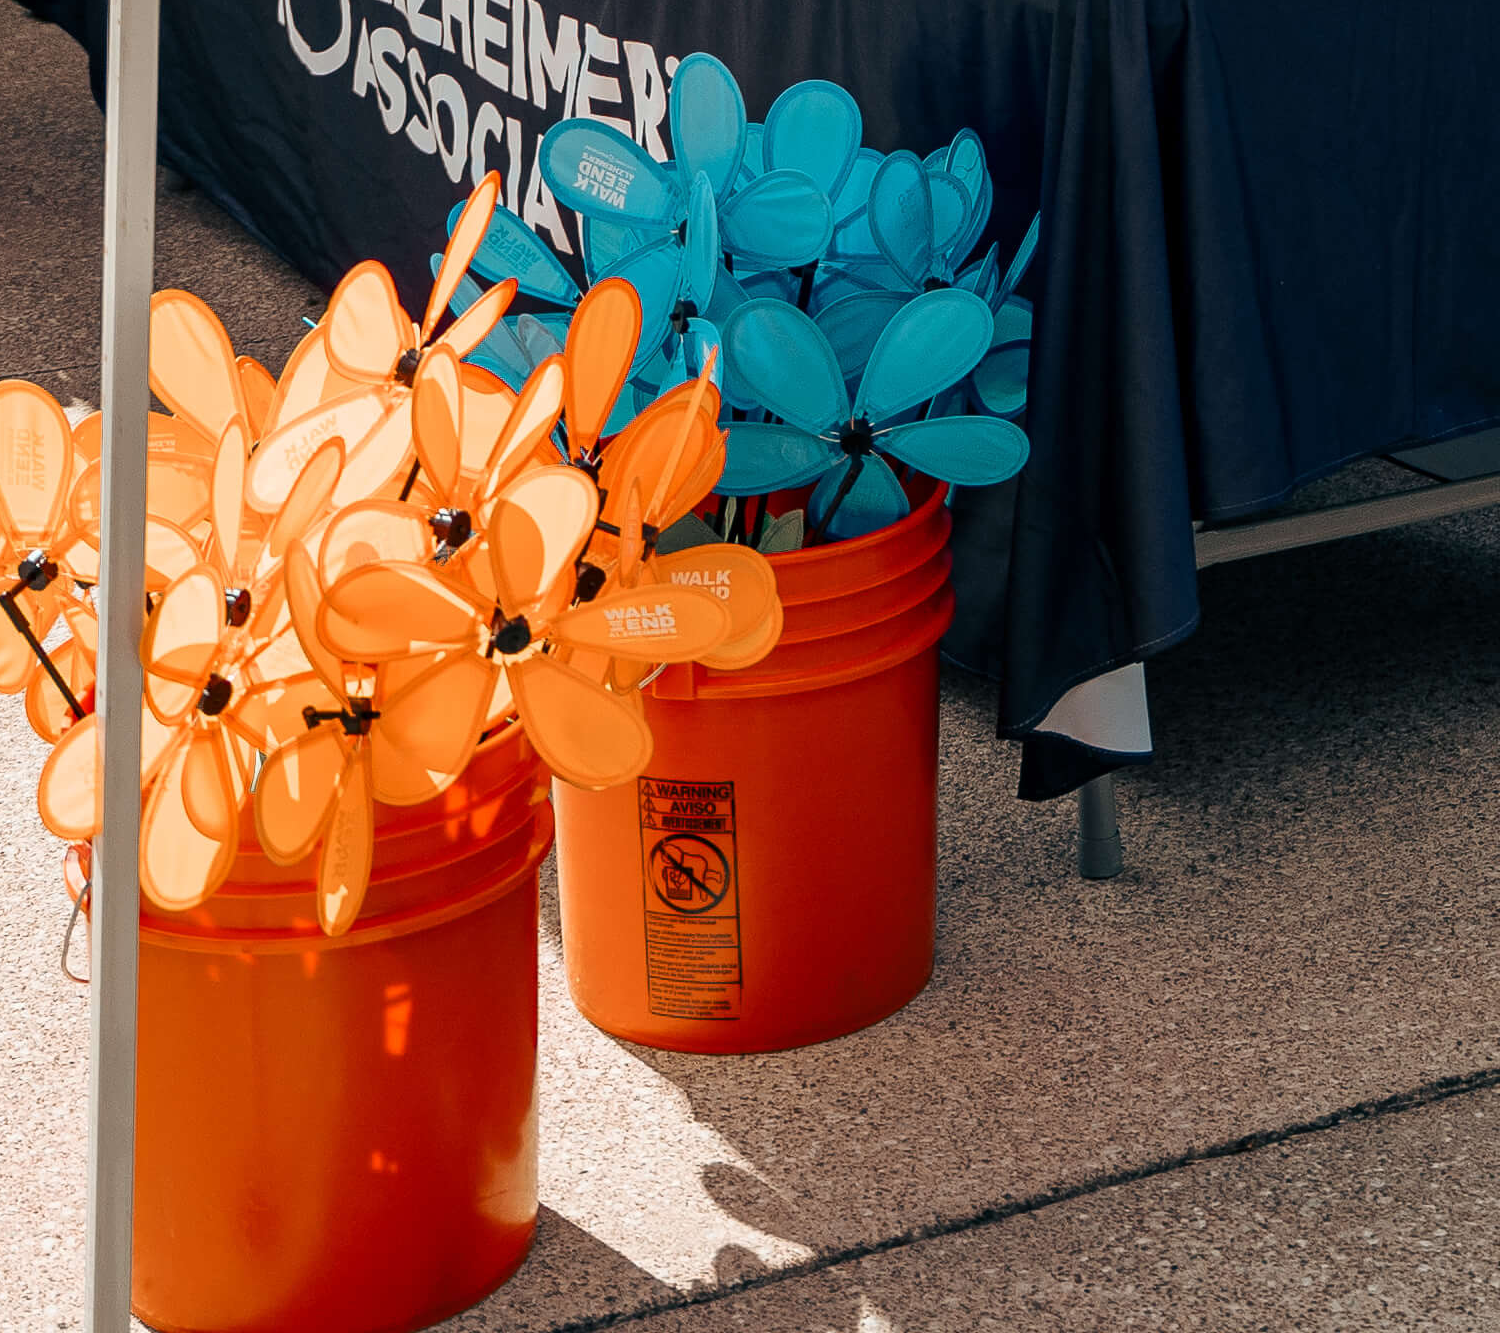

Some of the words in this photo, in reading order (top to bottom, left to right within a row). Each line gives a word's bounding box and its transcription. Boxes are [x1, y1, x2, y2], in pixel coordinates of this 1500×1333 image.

[352, 18, 580, 265] ASSOCIA
[579, 160, 617, 187] END
[572, 173, 626, 210] WALK
[670, 569, 732, 586] WALK
[603, 603, 672, 621] WALK
[626, 617, 676, 630] END
[655, 783, 730, 800] WARNING
[670, 801, 717, 814] AVISO
